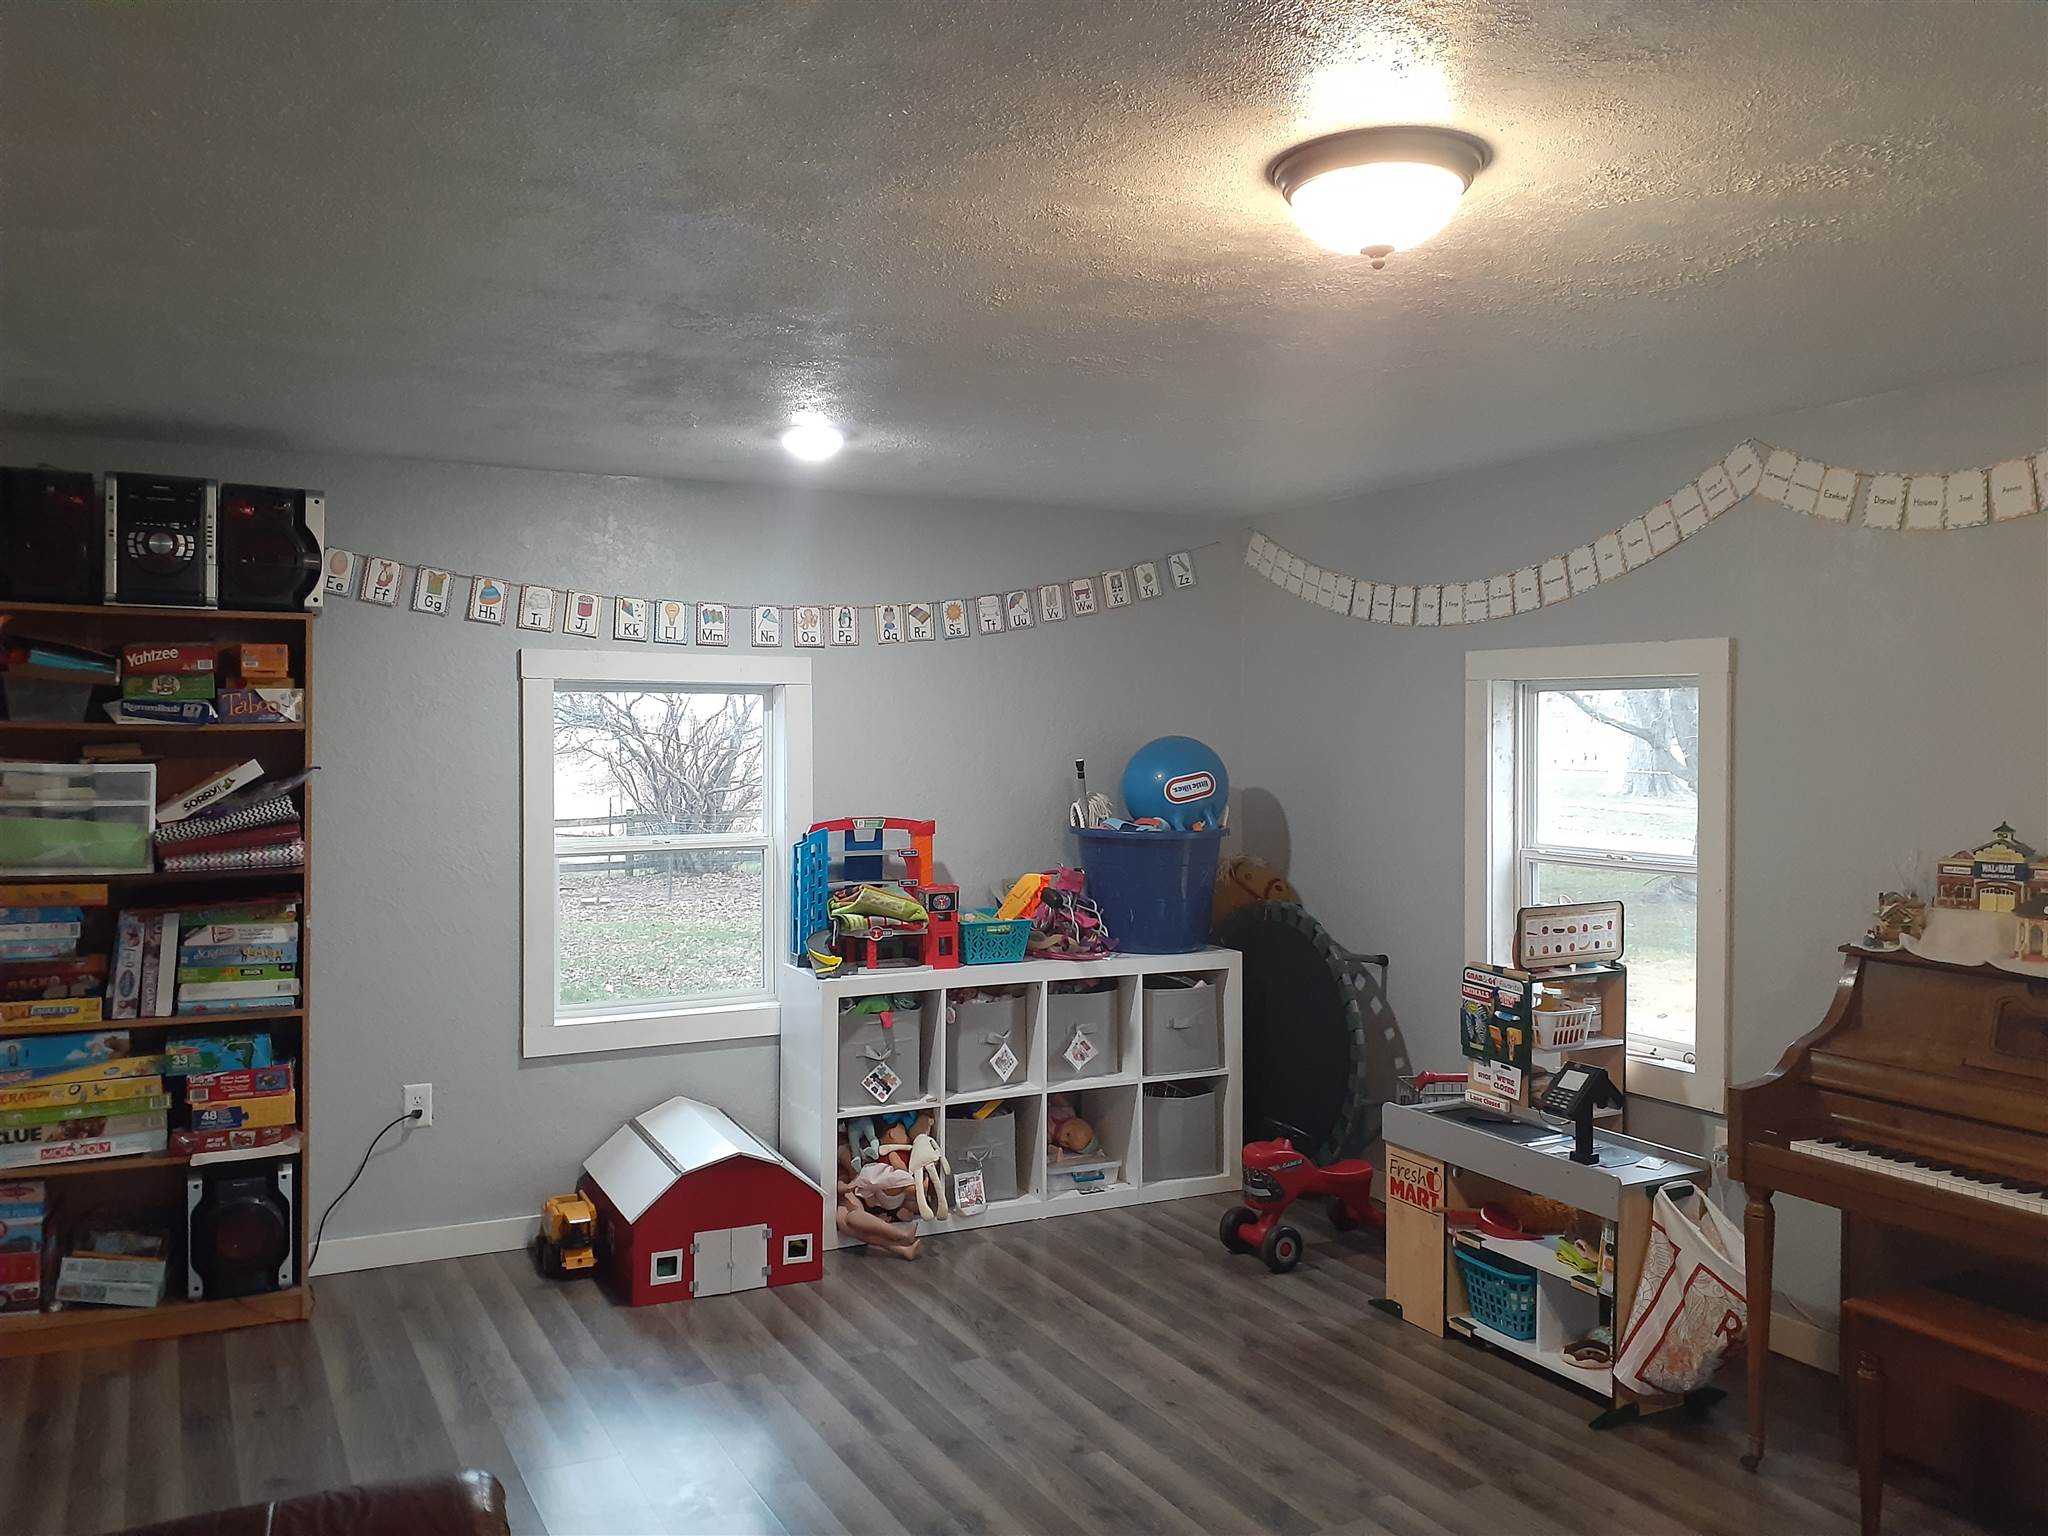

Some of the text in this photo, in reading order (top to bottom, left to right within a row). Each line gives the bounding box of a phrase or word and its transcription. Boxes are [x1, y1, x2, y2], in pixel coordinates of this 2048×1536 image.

[326, 576, 344, 591] Ee
[1177, 574, 1191, 586] Zz
[373, 587, 390, 601] Ff
[1142, 585, 1154, 597] Yy
[424, 596, 442, 612] Gg
[1112, 593, 1124, 604] Xx
[478, 605, 496, 620] Hh
[1076, 601, 1094, 612] Ww
[531, 613, 542, 626] Ii
[1047, 608, 1059, 619] Vv
[575, 618, 588, 633] Jj
[984, 619, 997, 631] Tt
[1013, 615, 1028, 626] Uu
[624, 623, 640, 636] Kk
[665, 626, 677, 640] Ll
[702, 630, 724, 641] Mm
[760, 630, 775, 642] Nn
[883, 629, 900, 642] Qq
[914, 627, 927, 639] Rr
[949, 624, 962, 635] Ss
[801, 631, 817, 643] Oo
[838, 630, 852, 644] Pp
[126, 648, 179, 667] Yahtzee
[222, 693, 280, 716] Taboo
[183, 784, 222, 811] SORRY!
[171, 1055, 188, 1065] 33
[201, 1111, 218, 1121] 48
[42, 1142, 110, 1159] MONOPOLY
[1390, 1159, 1426, 1187] Fresh
[1390, 1175, 1440, 1209] MART
